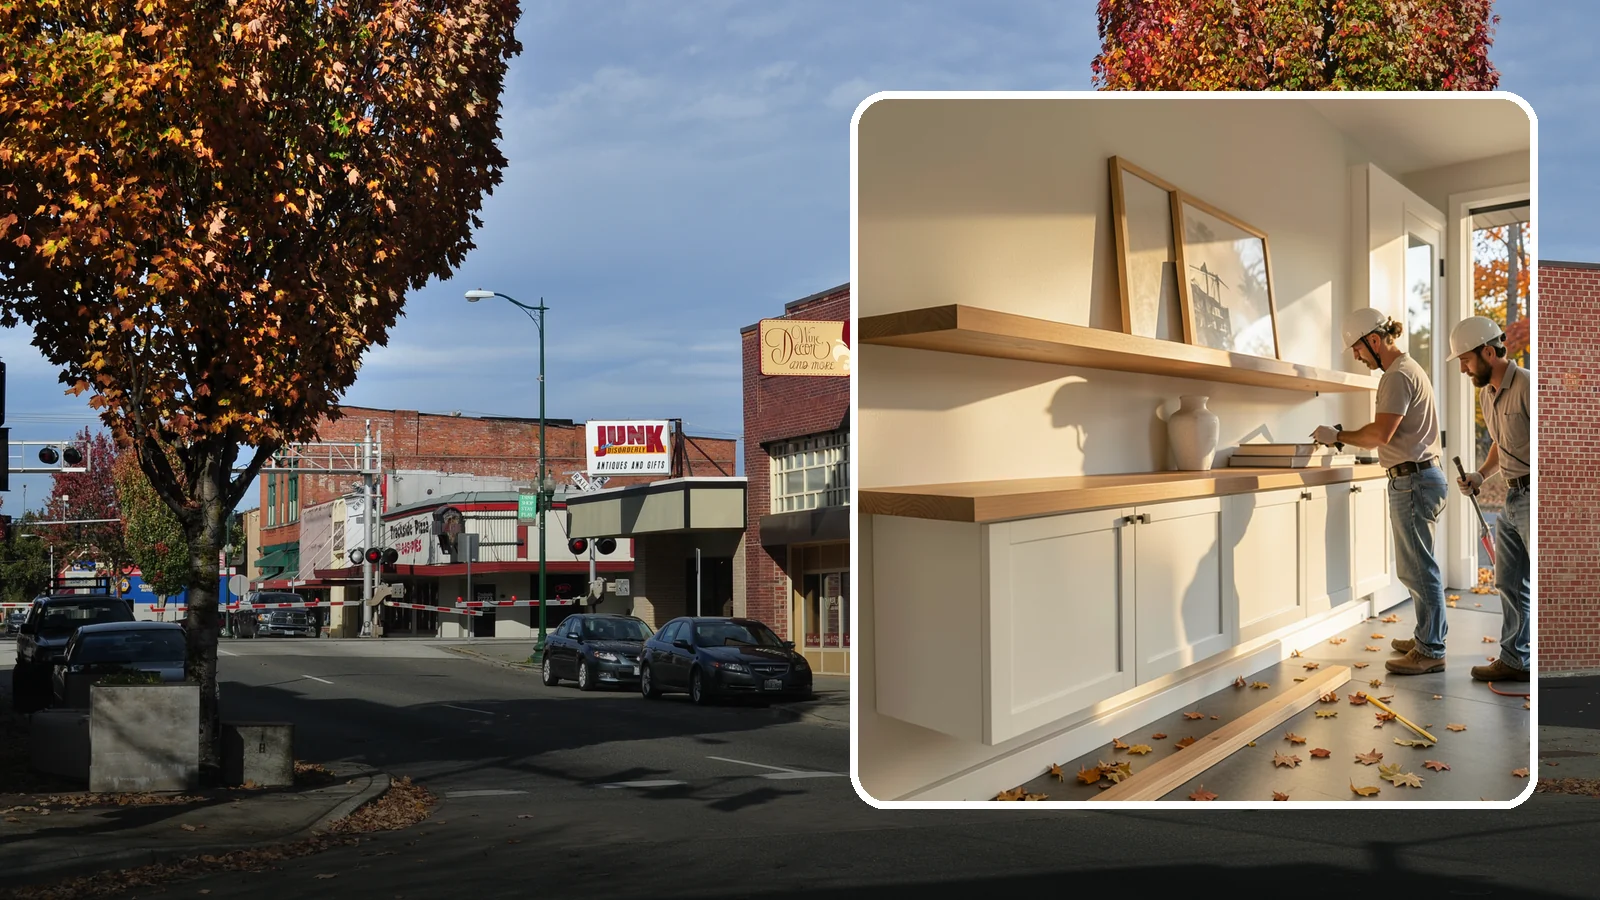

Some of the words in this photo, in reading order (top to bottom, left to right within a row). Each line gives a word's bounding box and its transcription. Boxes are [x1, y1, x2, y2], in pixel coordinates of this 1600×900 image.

[595, 425, 666, 457] JUNK
[607, 446, 646, 454] DISORDERLY
[596, 461, 628, 470] ANTIQUES
[631, 461, 644, 470] AND
[647, 460, 666, 470] GIFTS
[573, 473, 589, 492] RAIL
[390, 521, 413, 540] Trackside
[414, 519, 429, 535] Pizza
